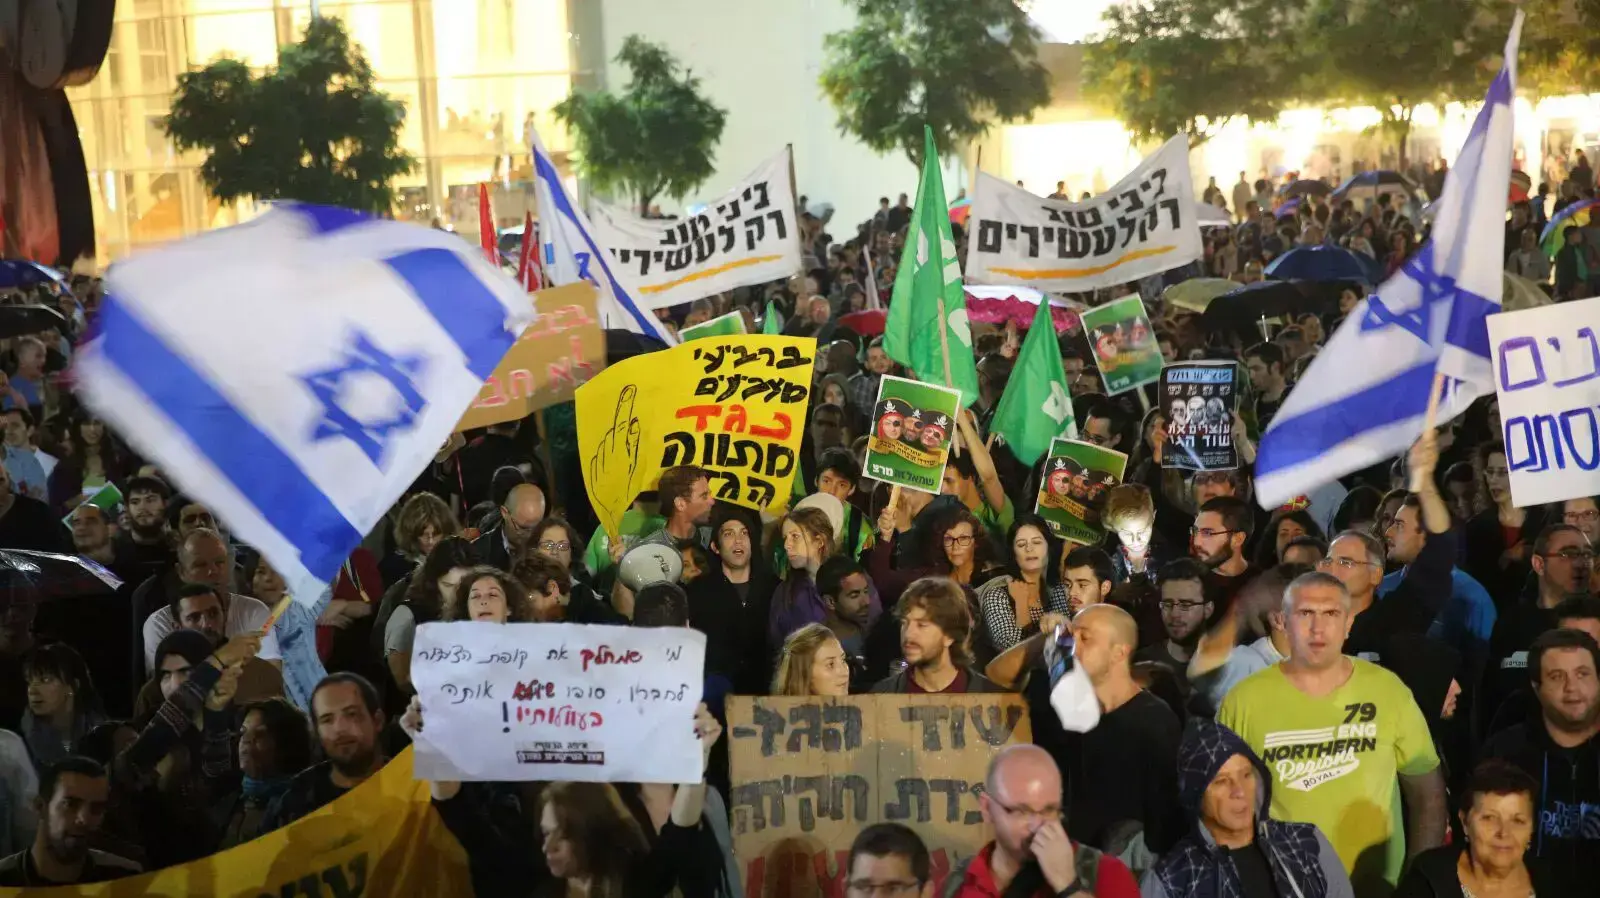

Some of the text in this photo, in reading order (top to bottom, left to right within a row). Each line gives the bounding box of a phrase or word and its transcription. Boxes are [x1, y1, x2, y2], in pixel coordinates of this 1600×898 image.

[610, 210, 787, 276] רק לעשירי
[694, 345, 812, 374] ברביעי
[1171, 371, 1189, 380] 7/11
[694, 374, 808, 404] מצביעים
[675, 404, 792, 440] נגד
[1168, 420, 1230, 434] עוצרים את
[1202, 435, 1230, 447] שוד
[660, 431, 795, 478] מתווה
[477, 649, 528, 670] קופת
[546, 645, 569, 661] את
[666, 646, 682, 662] מי
[441, 680, 494, 704] אותה
[1342, 702, 1377, 724] 79
[899, 704, 1023, 751] שוד
[1337, 723, 1377, 740] ENG
[1262, 738, 1377, 763] NORTHERN
